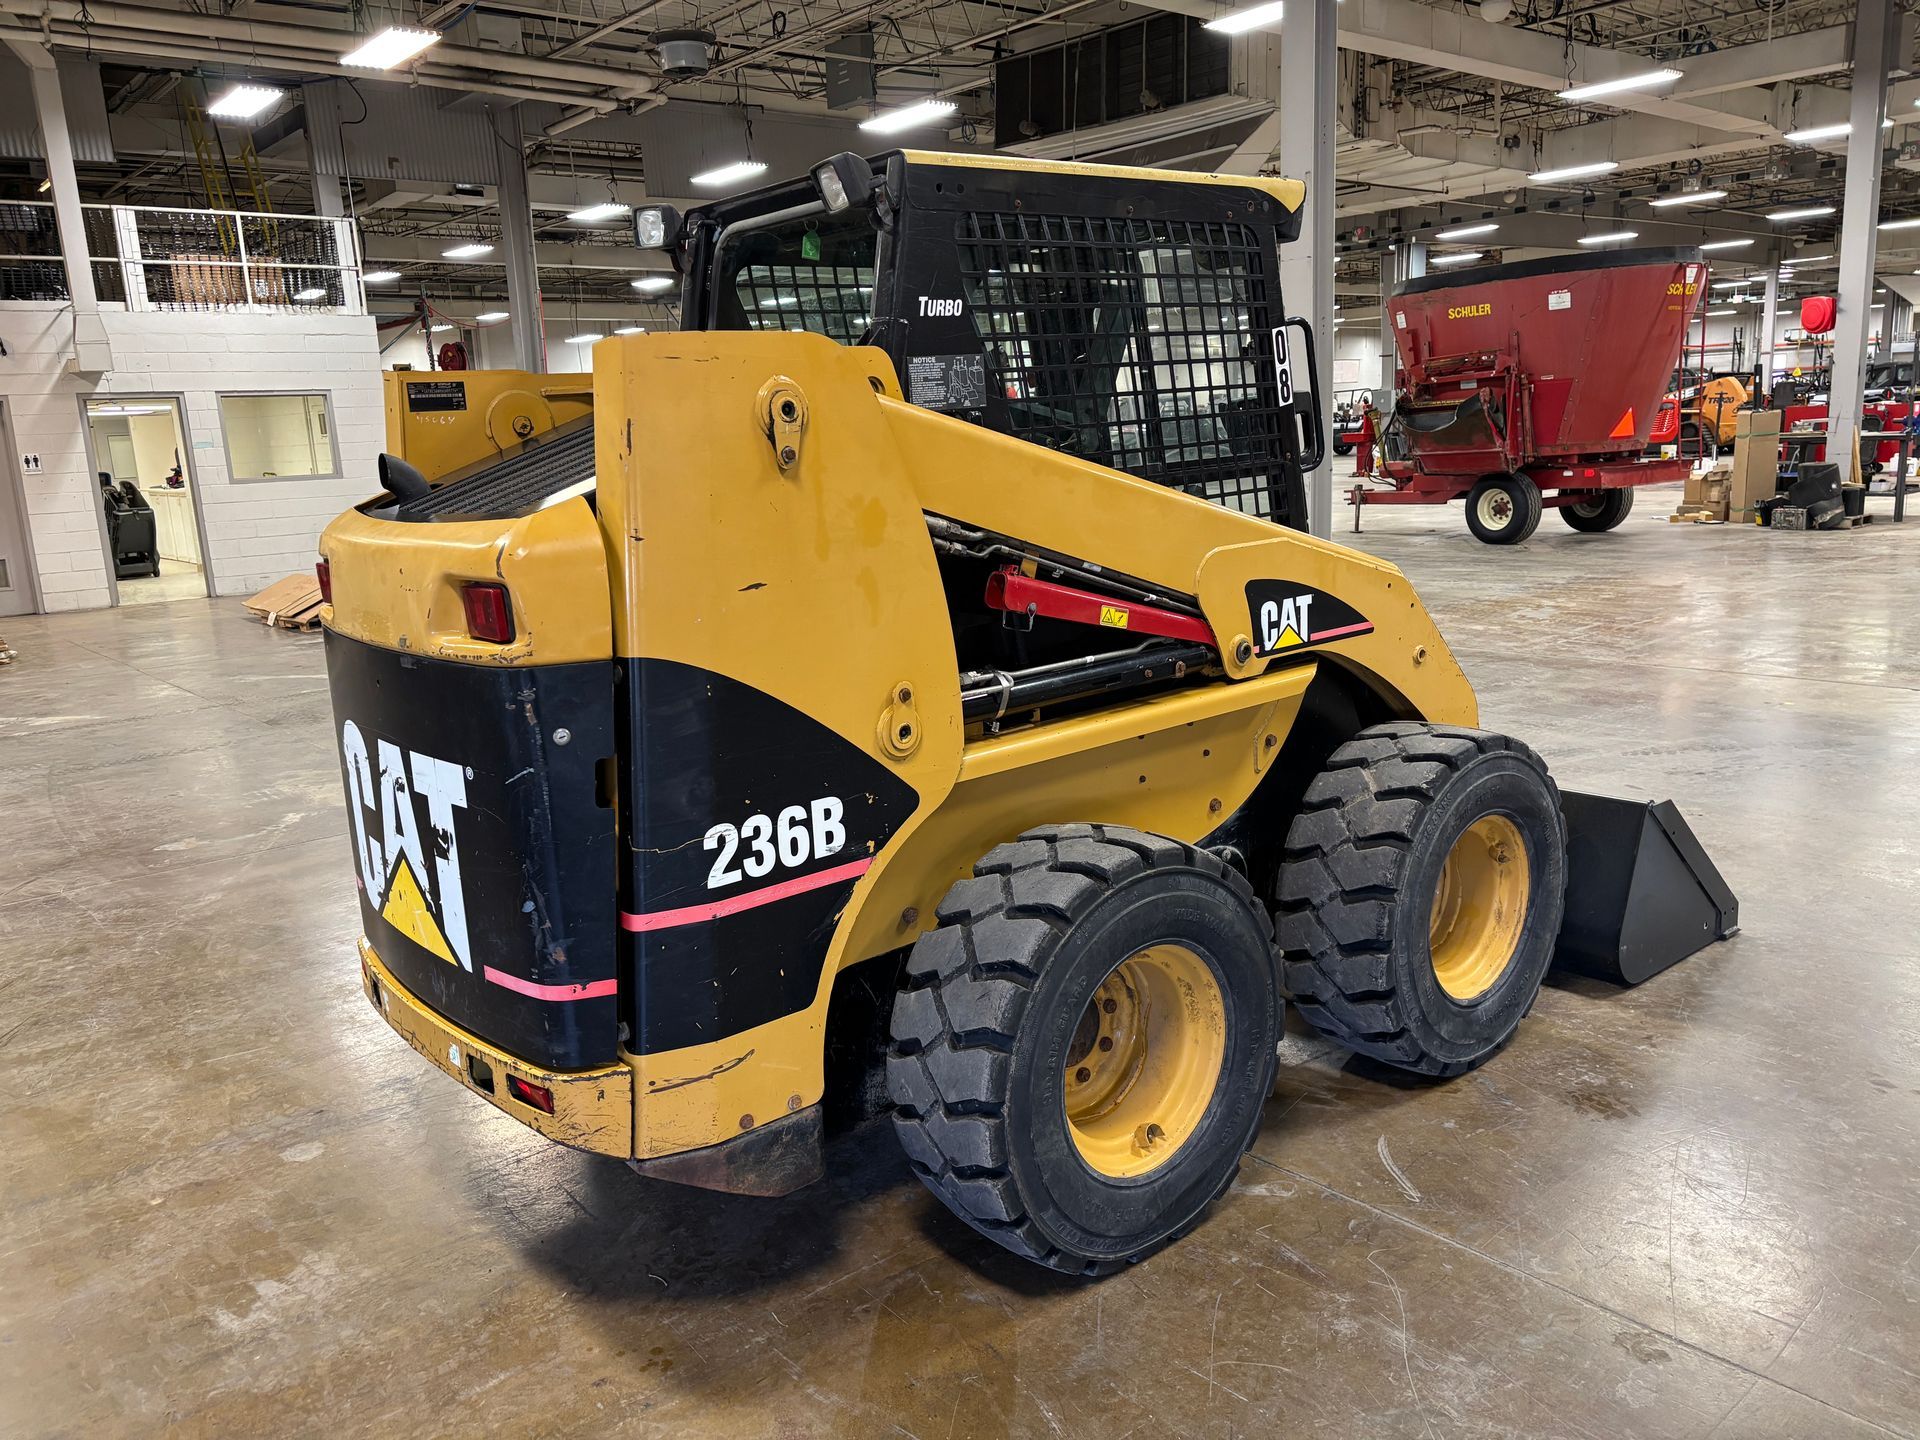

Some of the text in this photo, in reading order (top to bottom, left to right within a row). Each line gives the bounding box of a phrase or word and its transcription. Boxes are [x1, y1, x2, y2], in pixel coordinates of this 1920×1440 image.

[918, 296, 963, 317] TURBO
[1448, 303, 1492, 319] SCHULER
[1260, 594, 1313, 651] CAT
[343, 719, 474, 974] CAT
[703, 796, 847, 890] 236B
